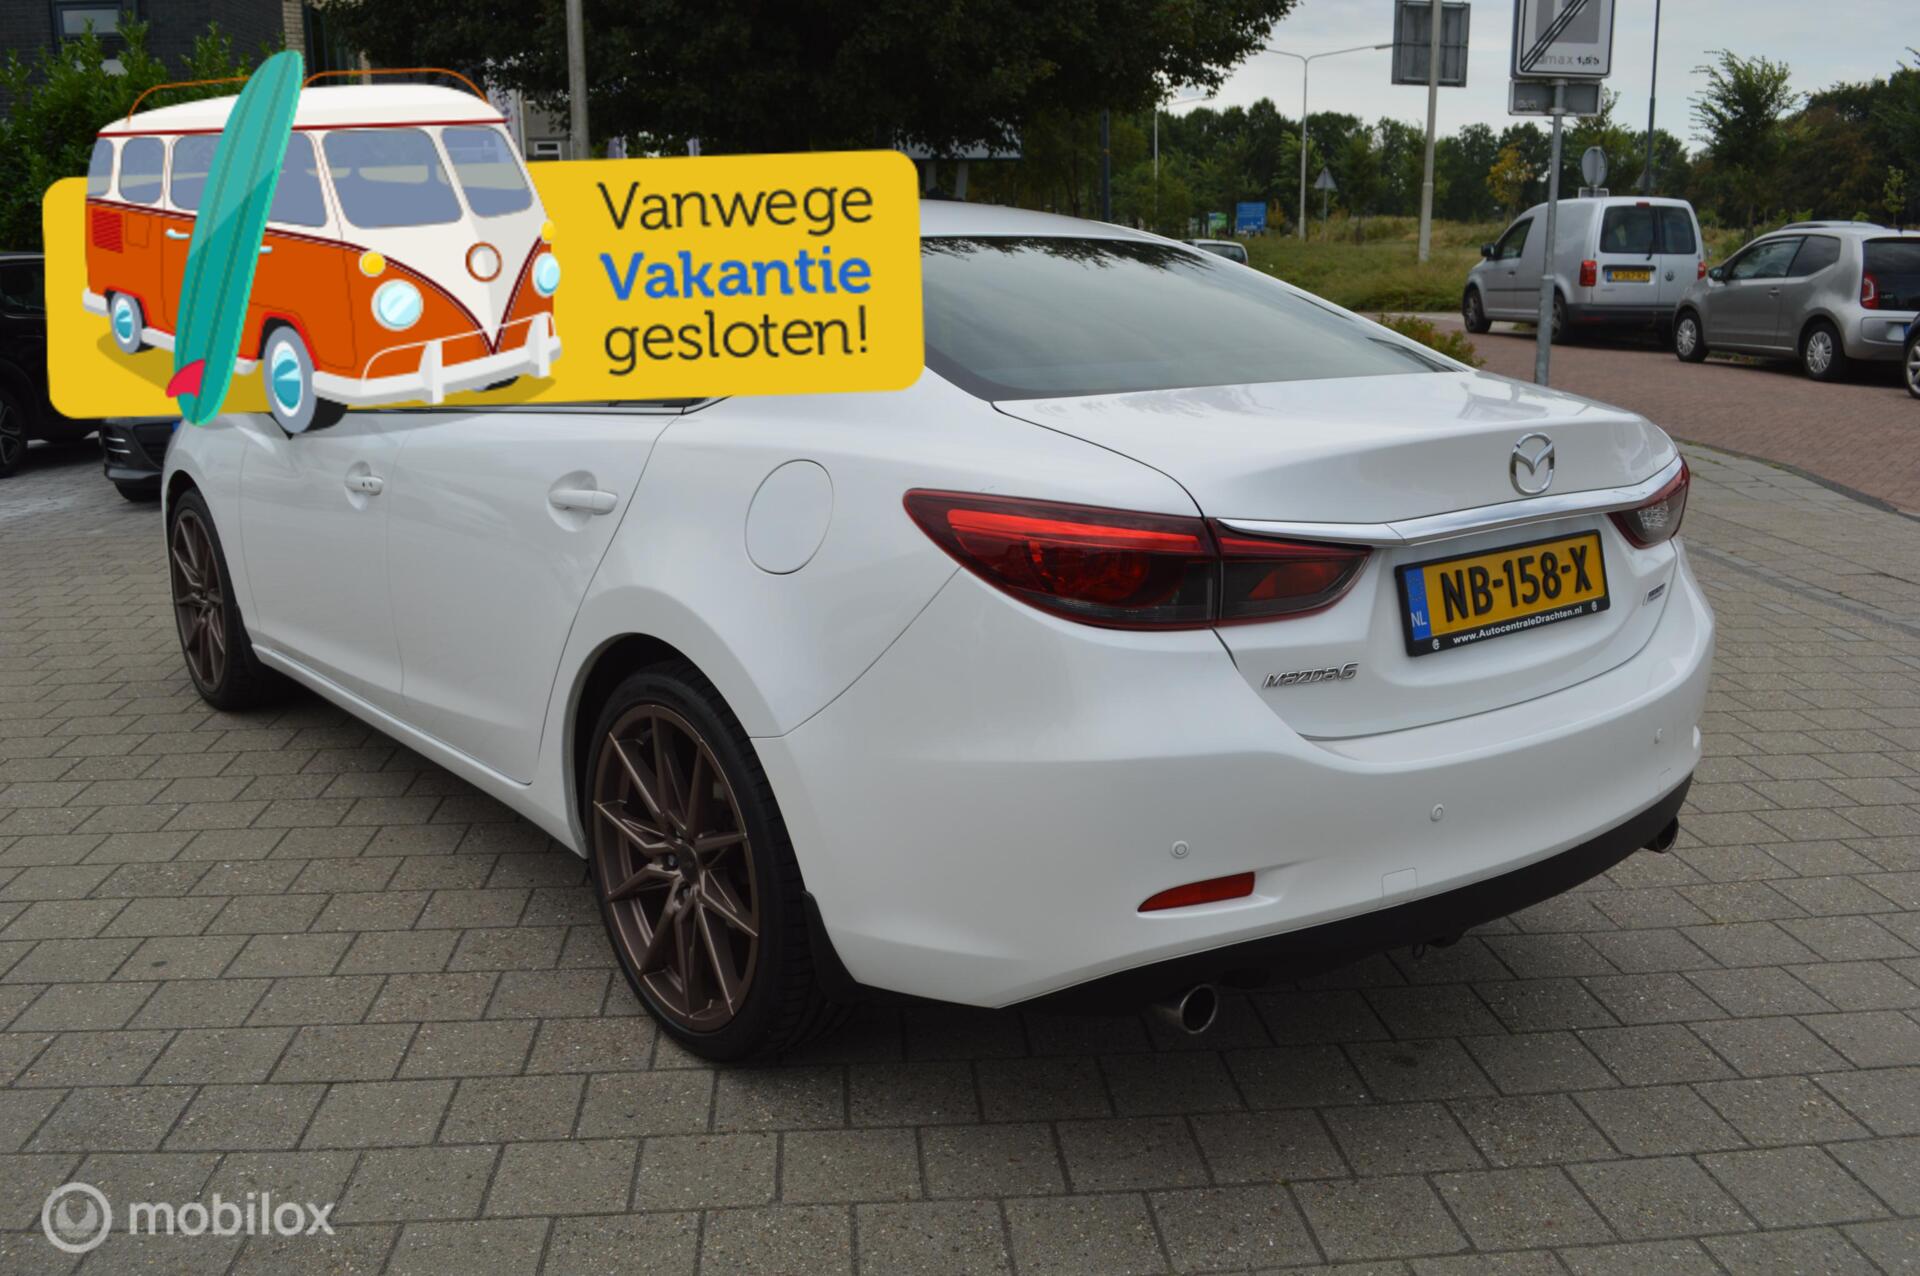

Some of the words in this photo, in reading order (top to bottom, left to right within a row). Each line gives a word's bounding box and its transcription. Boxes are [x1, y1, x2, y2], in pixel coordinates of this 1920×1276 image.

[1439, 544, 1593, 623] NB-158-X
[1410, 609, 1428, 629] NL
[1453, 606, 1583, 644] www.AutocentraleDrachten.nl
